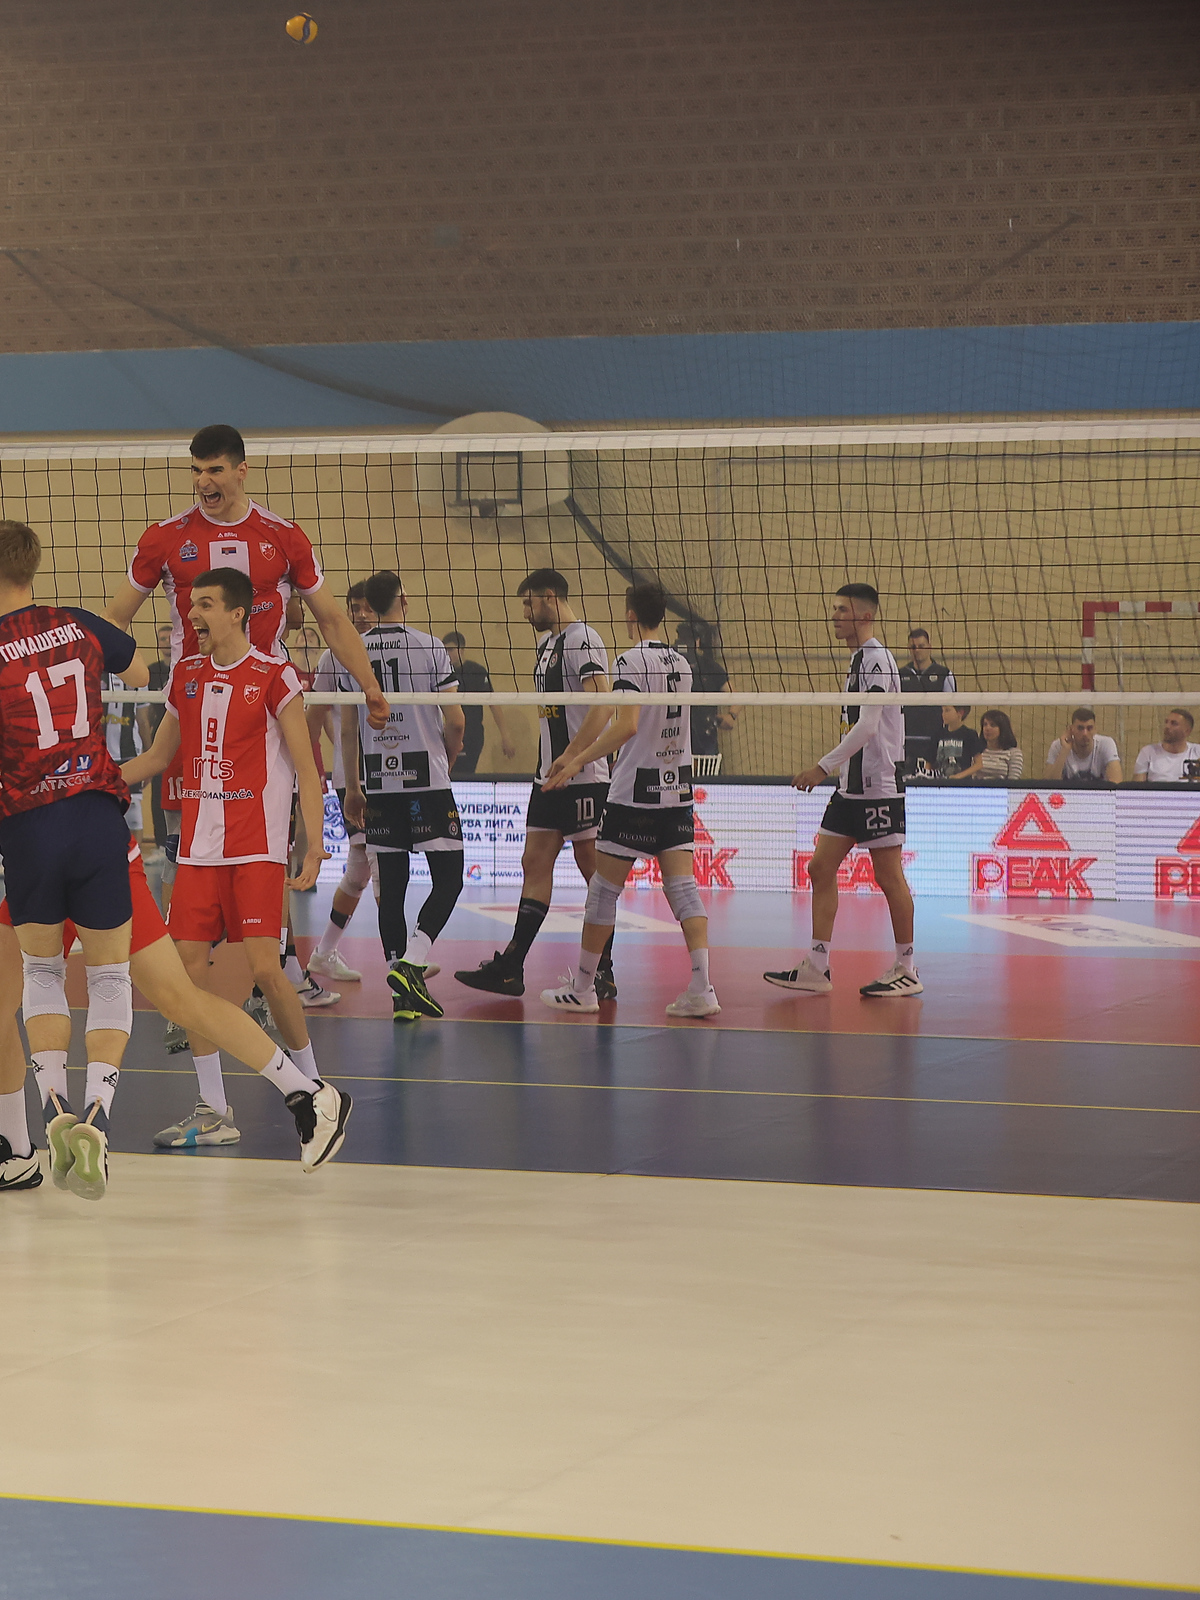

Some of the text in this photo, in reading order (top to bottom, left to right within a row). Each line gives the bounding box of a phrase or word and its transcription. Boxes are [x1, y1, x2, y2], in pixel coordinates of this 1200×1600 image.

[24, 657, 91, 751] 17
[575, 797, 595, 822] 10
[865, 805, 892, 830] 25
[460, 819, 515, 829] РВА ЛИГА
[504, 833, 526, 843] ЛИГ
[618, 831, 658, 844] DUOMOS
[324, 844, 341, 853] 921
[970, 852, 1098, 900] PEAK
